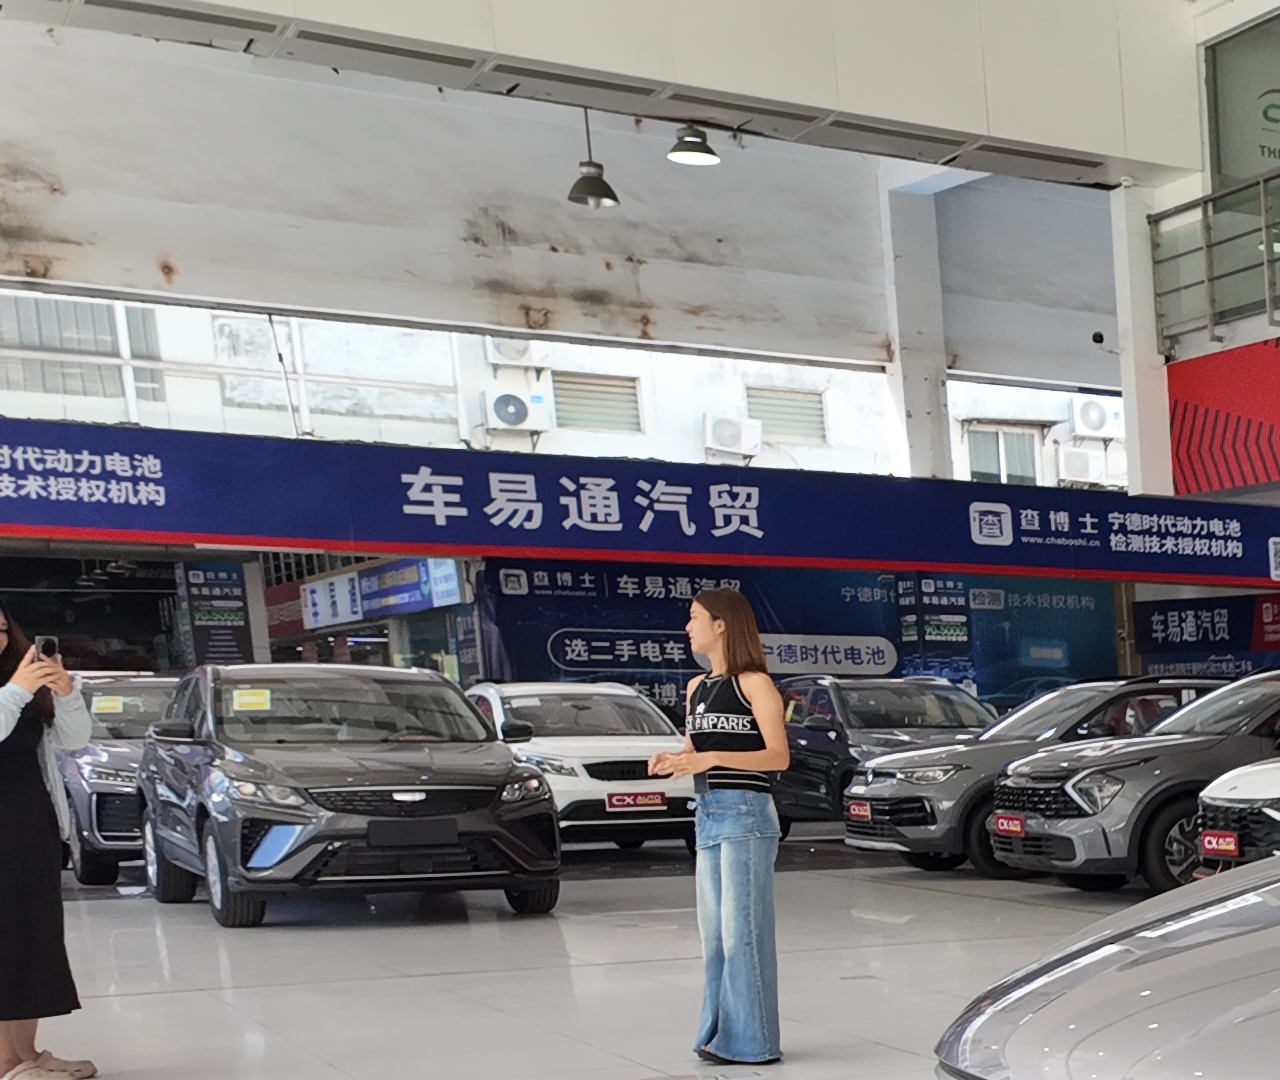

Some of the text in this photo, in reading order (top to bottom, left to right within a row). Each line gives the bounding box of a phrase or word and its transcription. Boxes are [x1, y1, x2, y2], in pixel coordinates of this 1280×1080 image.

[400, 465, 765, 539] 车易通汽贸
[1019, 509, 1099, 534] 查博士
[1108, 511, 1242, 538] 宁德时代动力电池
[1109, 535, 1243, 558] 检测技术授权机构
[1151, 608, 1230, 643] 车易通汽贸
[563, 638, 687, 663] 选二手电车
[611, 796, 635, 806] CX
